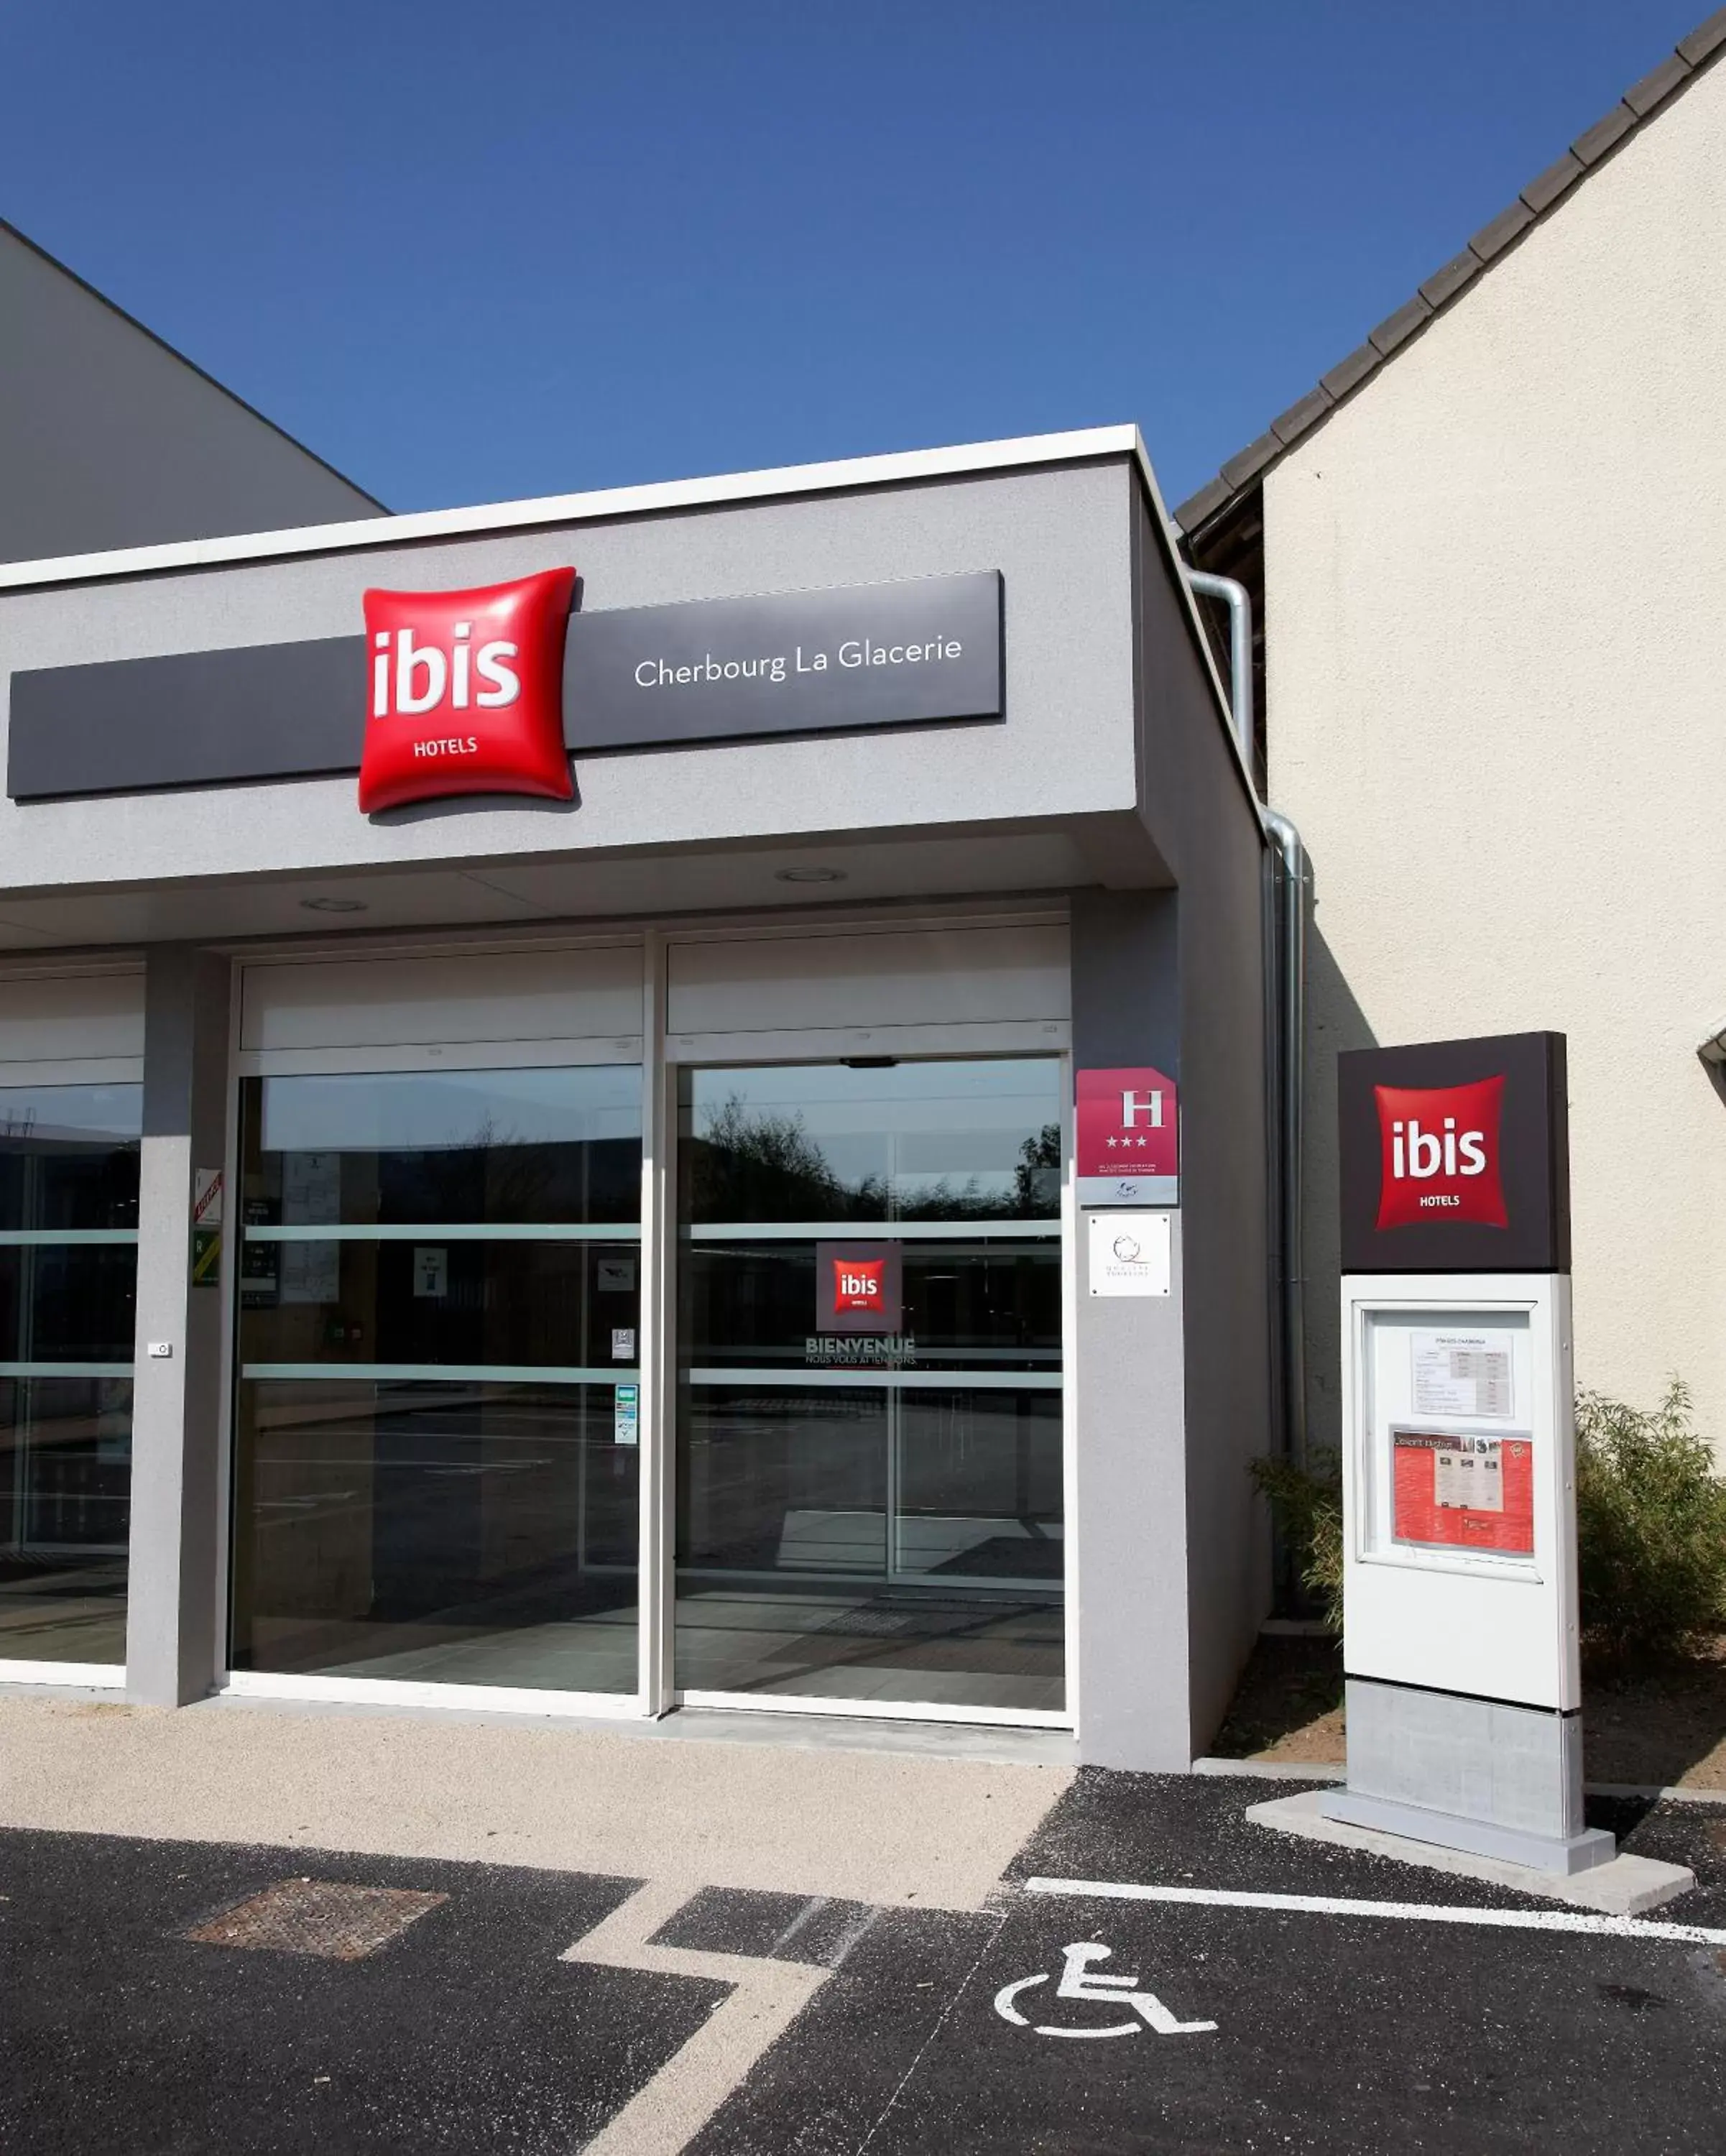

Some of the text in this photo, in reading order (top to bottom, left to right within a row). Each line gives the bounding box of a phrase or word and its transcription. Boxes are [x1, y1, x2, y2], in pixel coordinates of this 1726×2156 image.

[374, 621, 521, 719] ibis
[634, 635, 962, 687] Cherbourg La Glacerie
[413, 736, 479, 757] HOTELS
[1120, 1090, 1167, 1128] H
[1393, 1117, 1487, 1179] ibis
[1419, 1195, 1460, 1207] HOTELS
[841, 1273, 877, 1295] ibis
[806, 1337, 915, 1353] BIENVENUE
